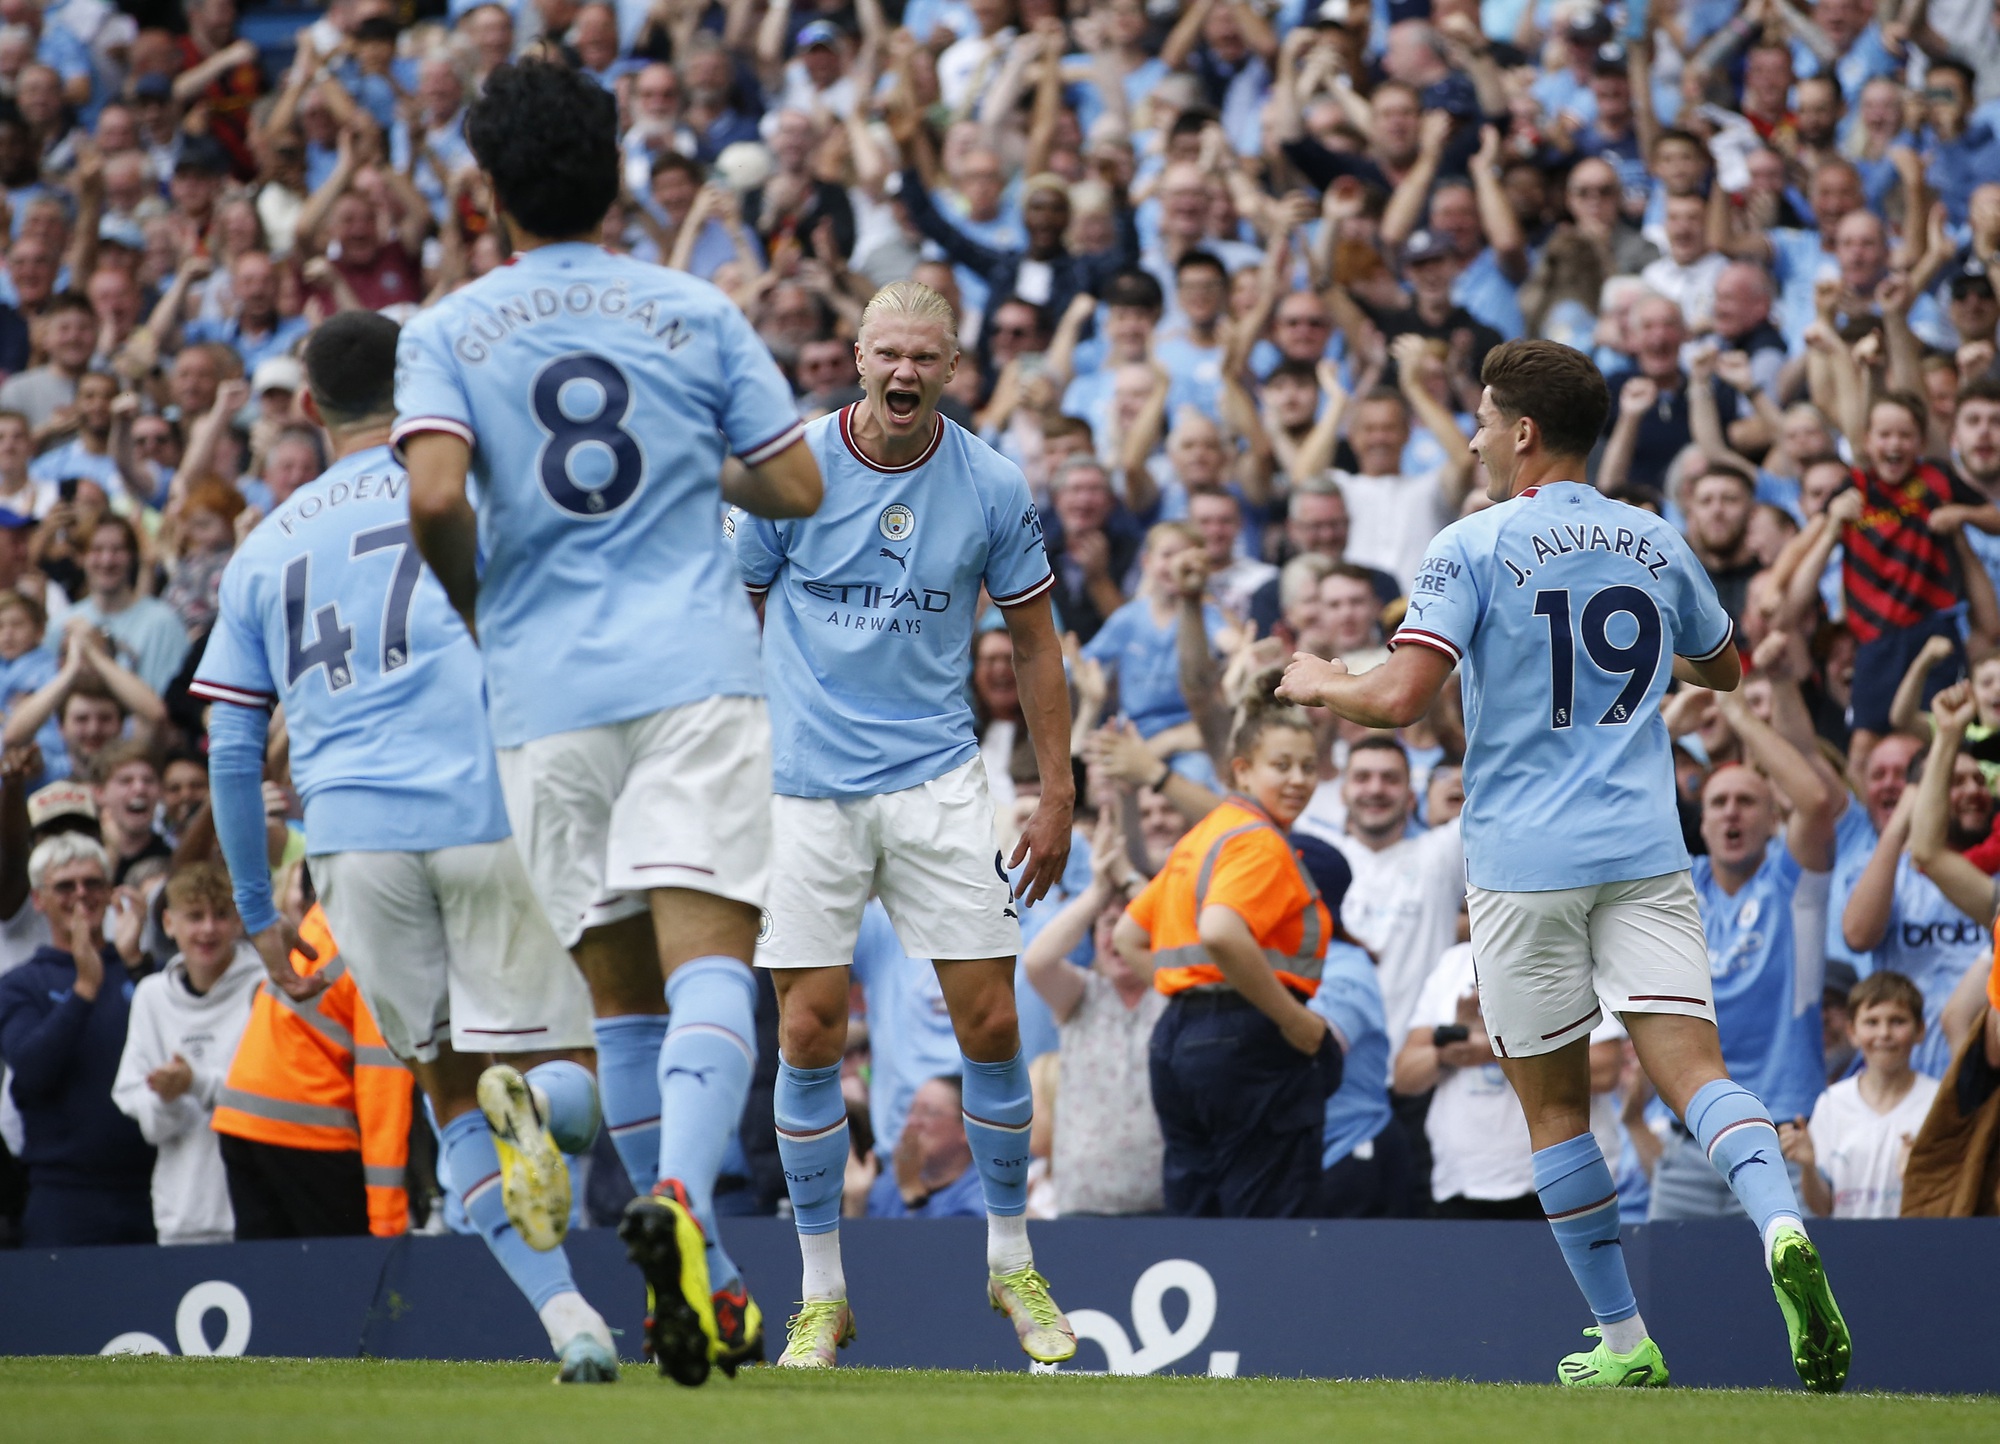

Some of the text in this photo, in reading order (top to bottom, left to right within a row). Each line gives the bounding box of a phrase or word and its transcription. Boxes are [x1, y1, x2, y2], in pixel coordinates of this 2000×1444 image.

[527, 350, 650, 522] 8
[278, 474, 409, 536] FODEN
[1505, 524, 1670, 589] J. ALVAREZ
[281, 520, 423, 696] 47
[802, 580, 951, 613] ETIHAD
[827, 611, 922, 634] AIRWAYS
[1532, 583, 1664, 731] 19
[992, 1155, 1028, 1168] CIT
